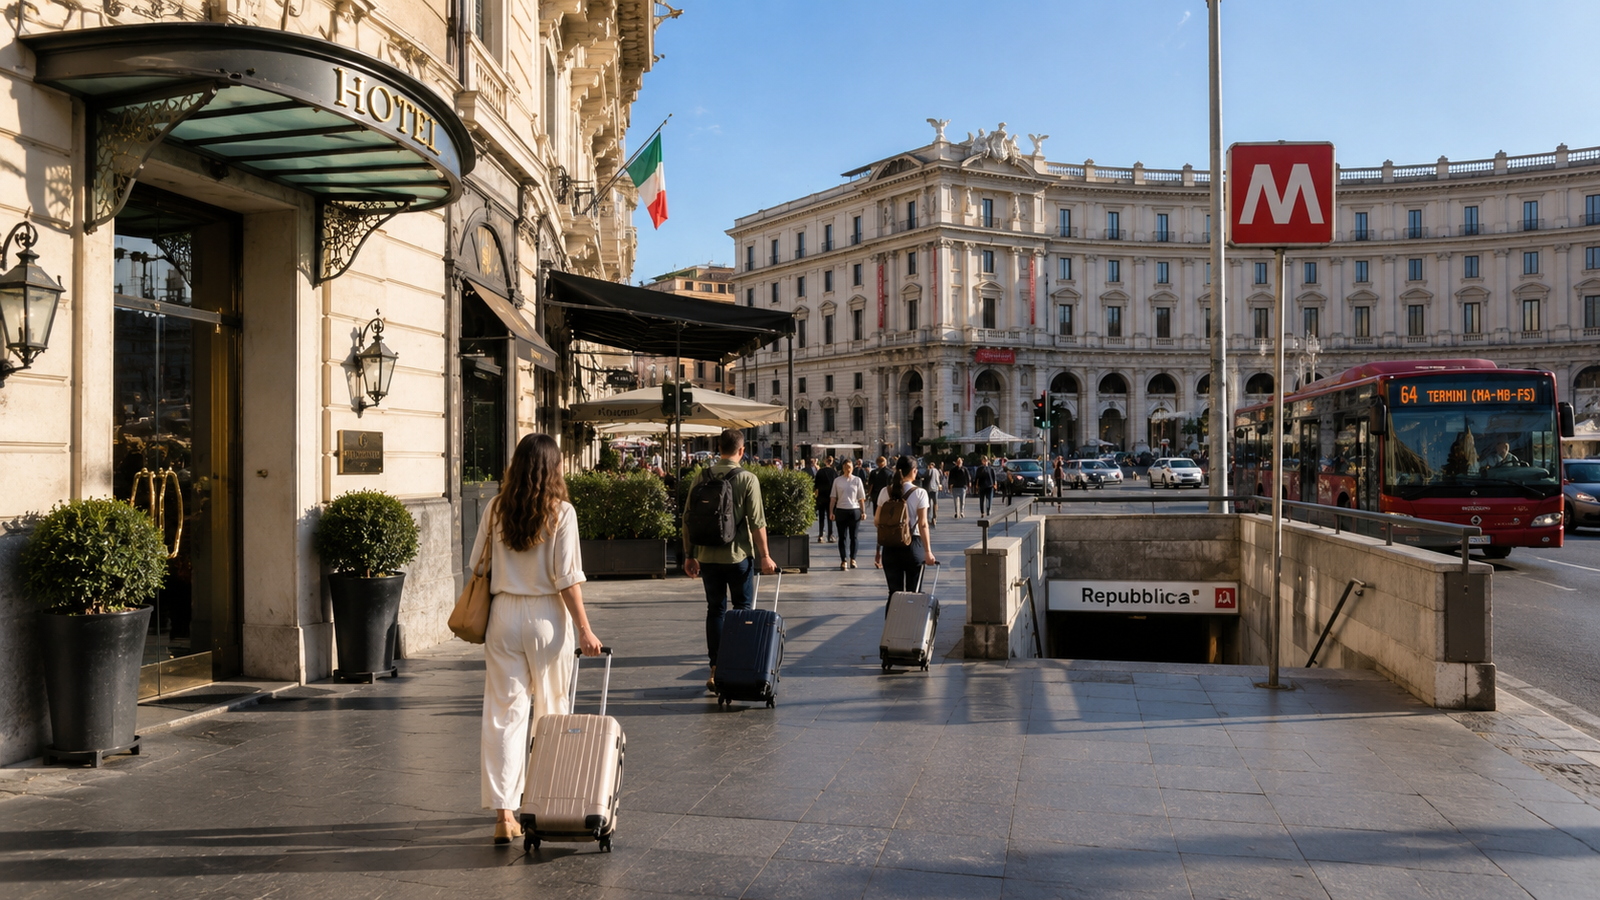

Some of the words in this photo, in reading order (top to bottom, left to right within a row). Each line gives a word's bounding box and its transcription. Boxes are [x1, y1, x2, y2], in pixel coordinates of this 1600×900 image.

[333, 67, 442, 156] HOTEL
[1239, 163, 1325, 224] M
[1401, 385, 1418, 404] 64
[1427, 389, 1467, 403] TERMINI
[1471, 388, 1536, 404] (MA-MB-FS)
[1081, 587, 1191, 607] Repubblica
